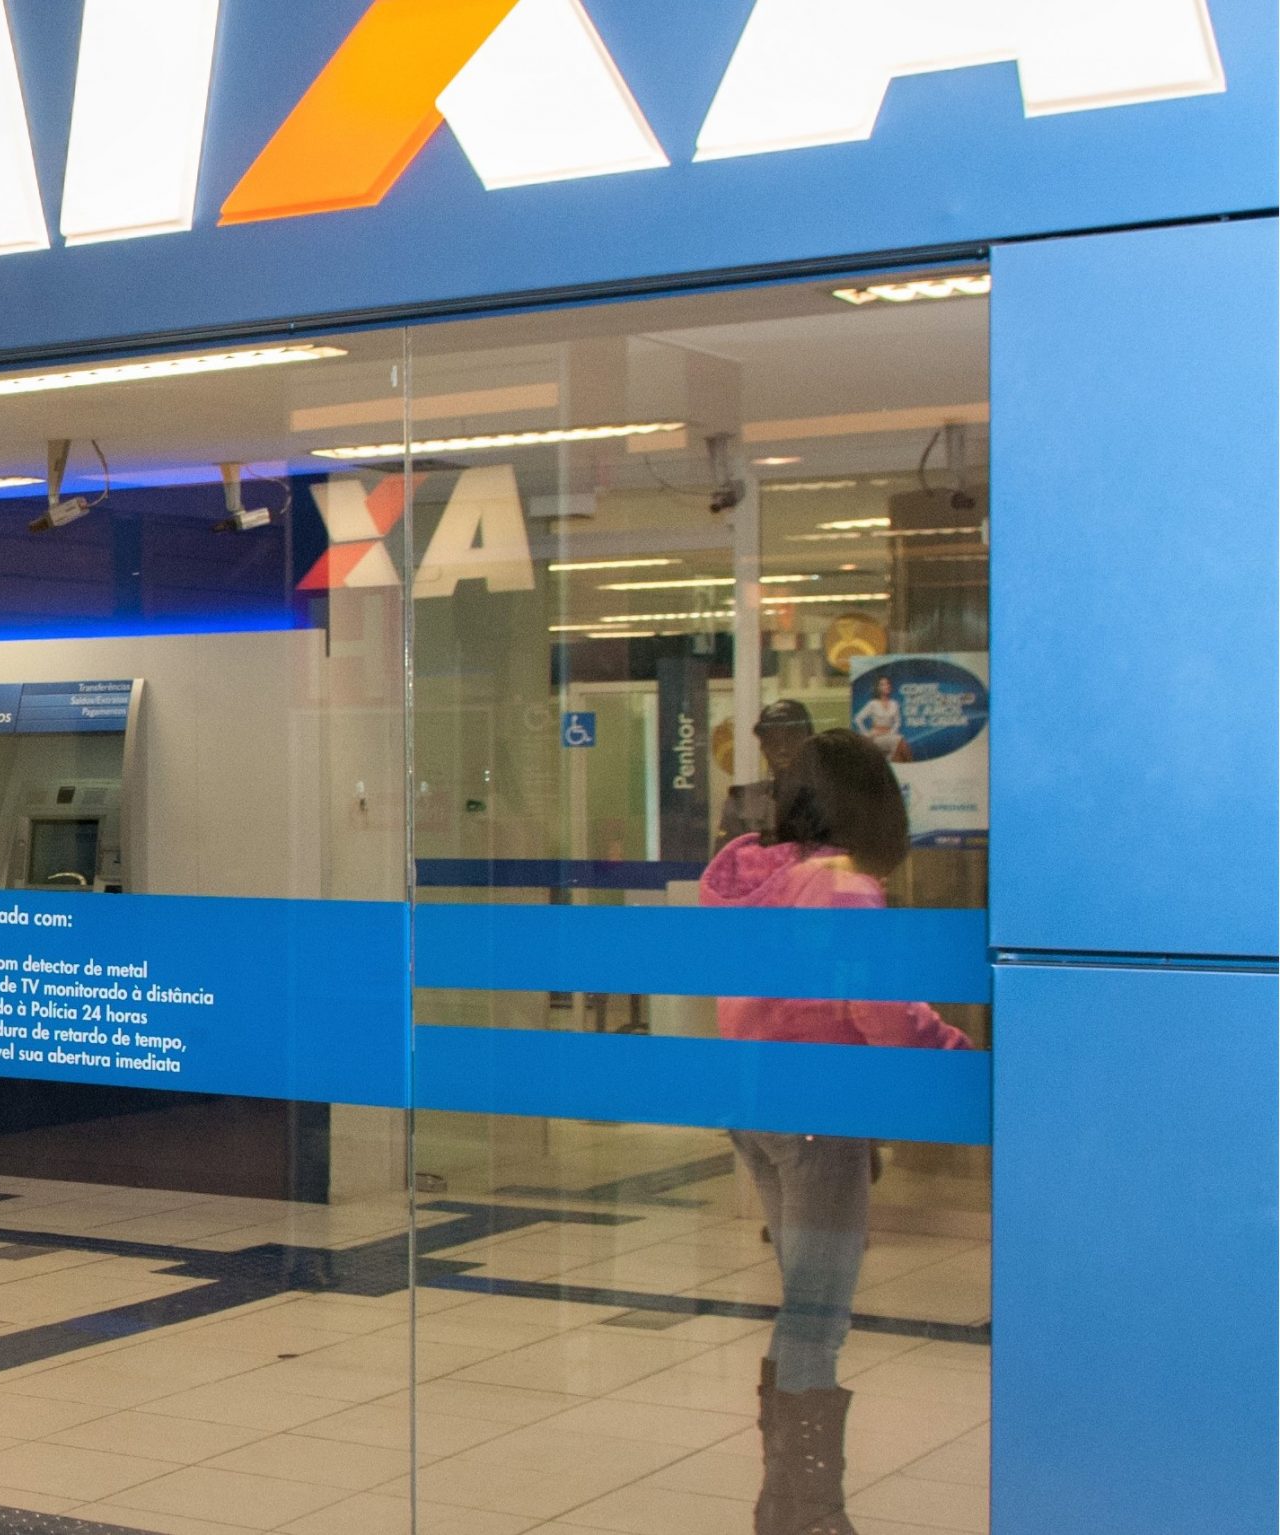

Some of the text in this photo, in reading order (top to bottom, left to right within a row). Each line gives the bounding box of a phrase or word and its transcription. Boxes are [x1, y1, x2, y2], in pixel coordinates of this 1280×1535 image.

[673, 712, 695, 789] Penhor
[34, 913, 73, 928] com:
[23, 954, 80, 975] detector
[84, 958, 102, 976] de
[107, 960, 148, 978] metal
[0, 975, 17, 993] de
[21, 977, 39, 994] TV
[44, 981, 127, 1000] monitorado
[132, 985, 142, 1001] à
[147, 984, 214, 1005] distância
[17, 1001, 27, 1016] à
[31, 1000, 77, 1019] Polícia
[82, 1005, 101, 1022] 24
[106, 1004, 148, 1025] horas
[31, 1022, 50, 1040] de
[54, 1026, 108, 1044] retardo
[112, 1028, 130, 1046] de
[135, 1032, 187, 1053] tempo,
[18, 1049, 43, 1062] sua
[48, 1046, 111, 1067] abertura
[115, 1052, 181, 1073] imediata
